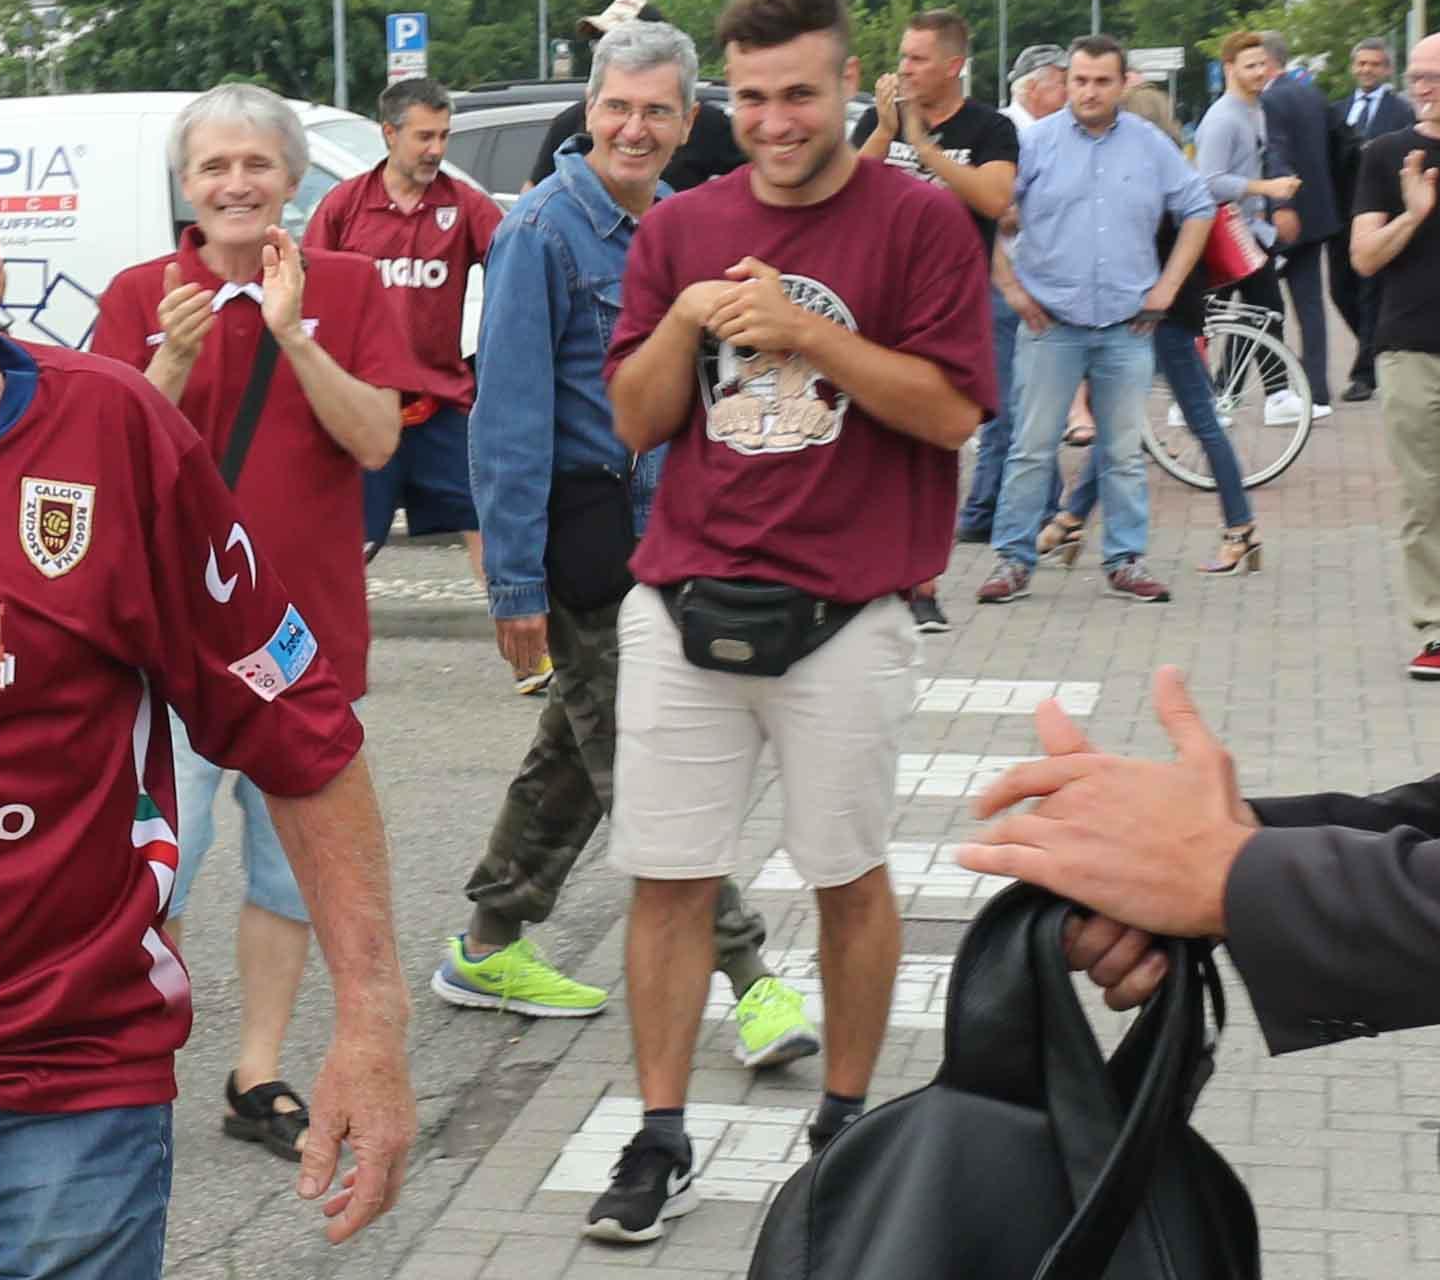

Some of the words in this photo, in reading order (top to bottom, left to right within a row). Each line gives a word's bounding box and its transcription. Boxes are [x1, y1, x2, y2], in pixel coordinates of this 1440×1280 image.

[395, 17, 420, 48] P
[35, 485, 82, 500] CALCIO
[52, 507, 87, 569] REGGIANA
